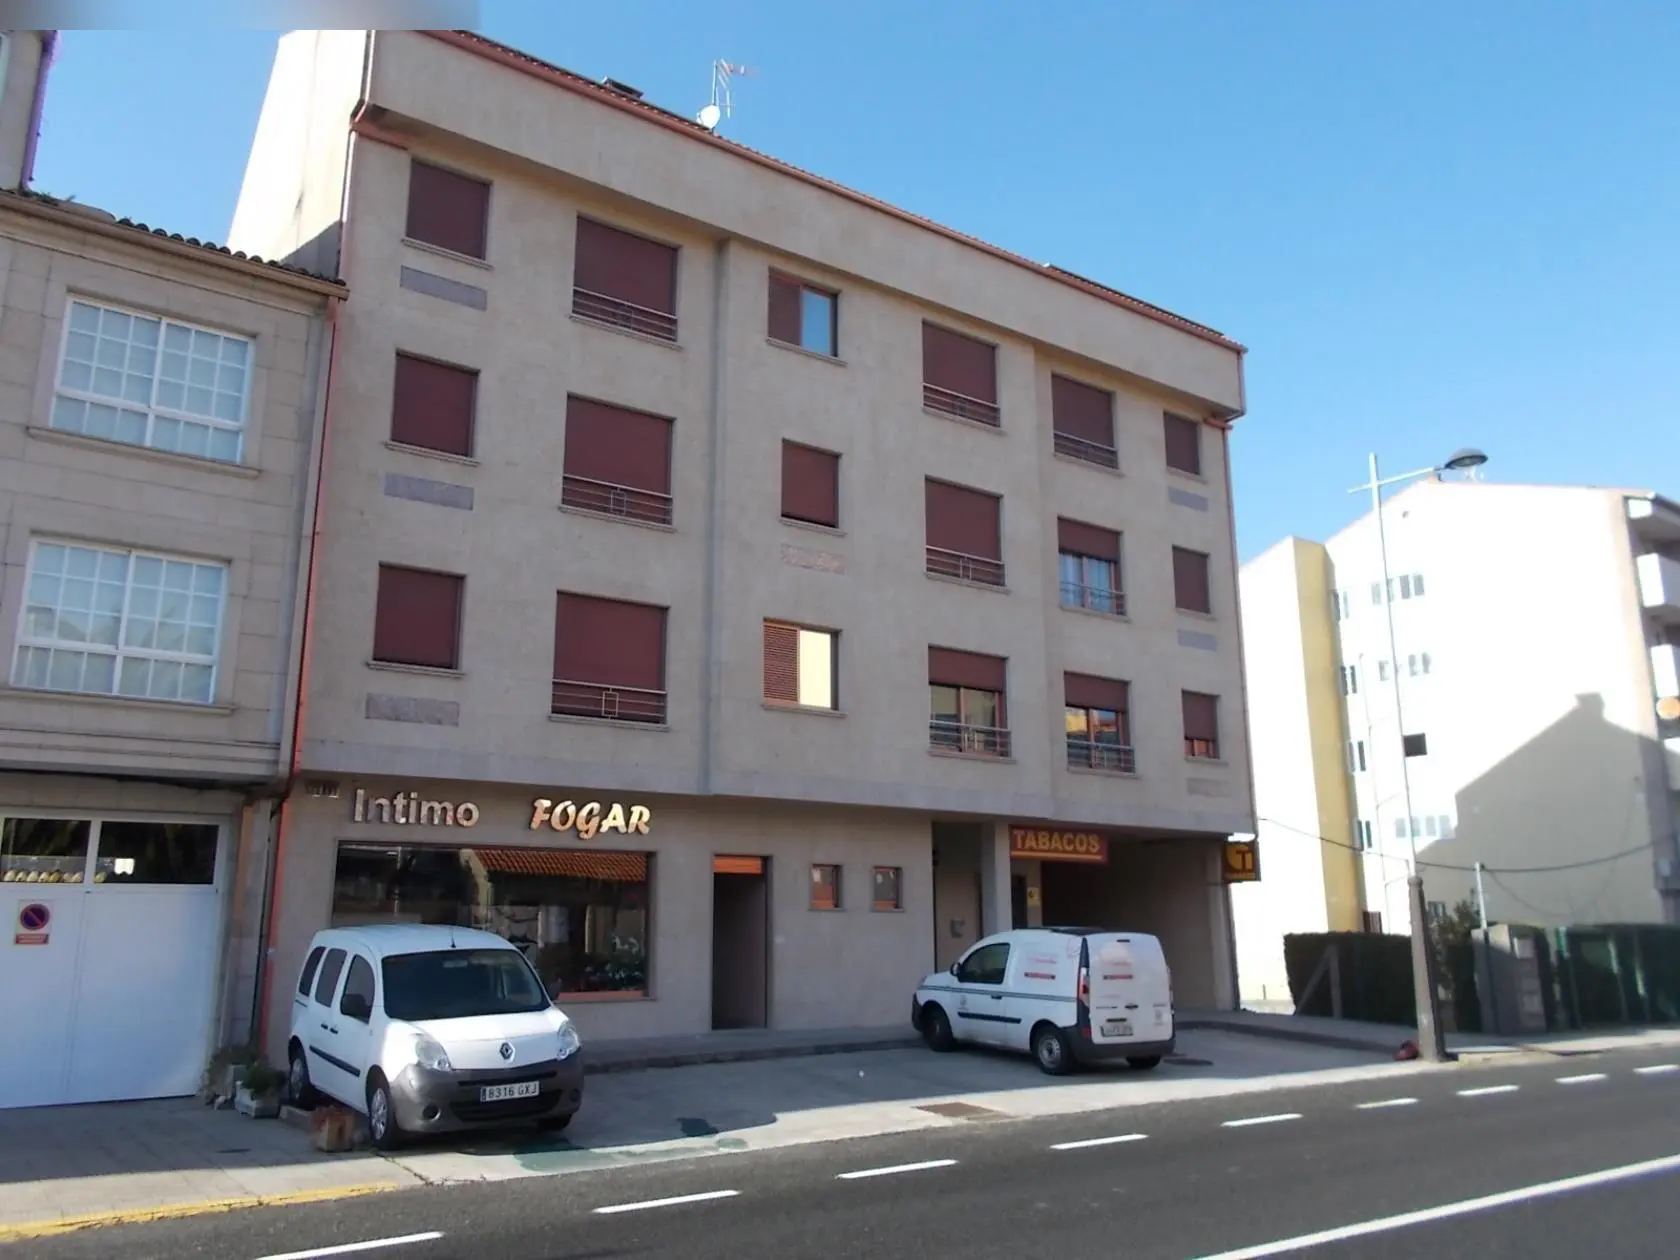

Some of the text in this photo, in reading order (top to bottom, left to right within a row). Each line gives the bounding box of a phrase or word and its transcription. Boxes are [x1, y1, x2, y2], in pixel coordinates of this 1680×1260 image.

[353, 788, 651, 840] Intimo FOGAR
[1012, 829, 1100, 853] TABACOS
[488, 1083, 537, 1099] 8316 GXJ
